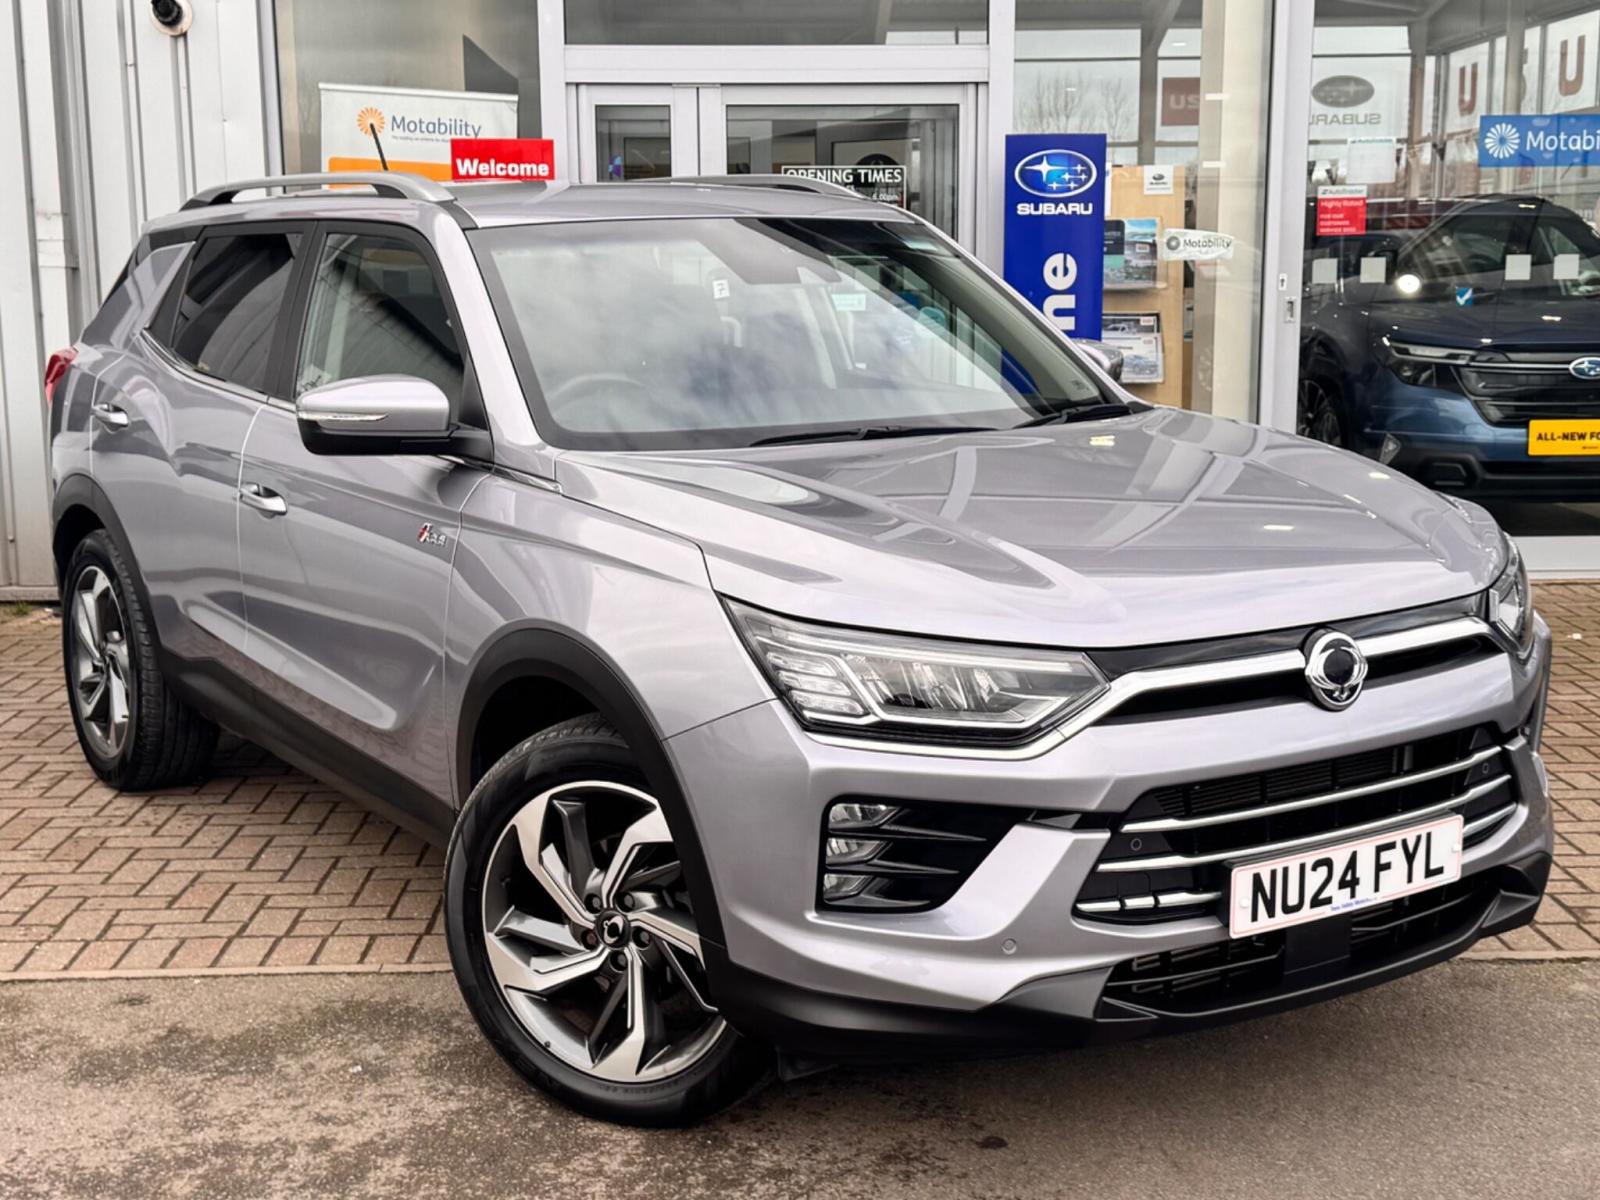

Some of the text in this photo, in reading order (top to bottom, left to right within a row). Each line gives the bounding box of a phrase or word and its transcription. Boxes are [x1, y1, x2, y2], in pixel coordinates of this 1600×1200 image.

[391, 115, 482, 139] Motability
[1526, 129, 1600, 151] Motabi
[456, 158, 549, 176] Welcome
[857, 169, 902, 183] TIMES
[1017, 203, 1093, 215] SUBARU
[1184, 238, 1232, 249] Motability
[1537, 432, 1587, 441] ALL-NEW
[1251, 832, 1445, 922] NU24 FYL
